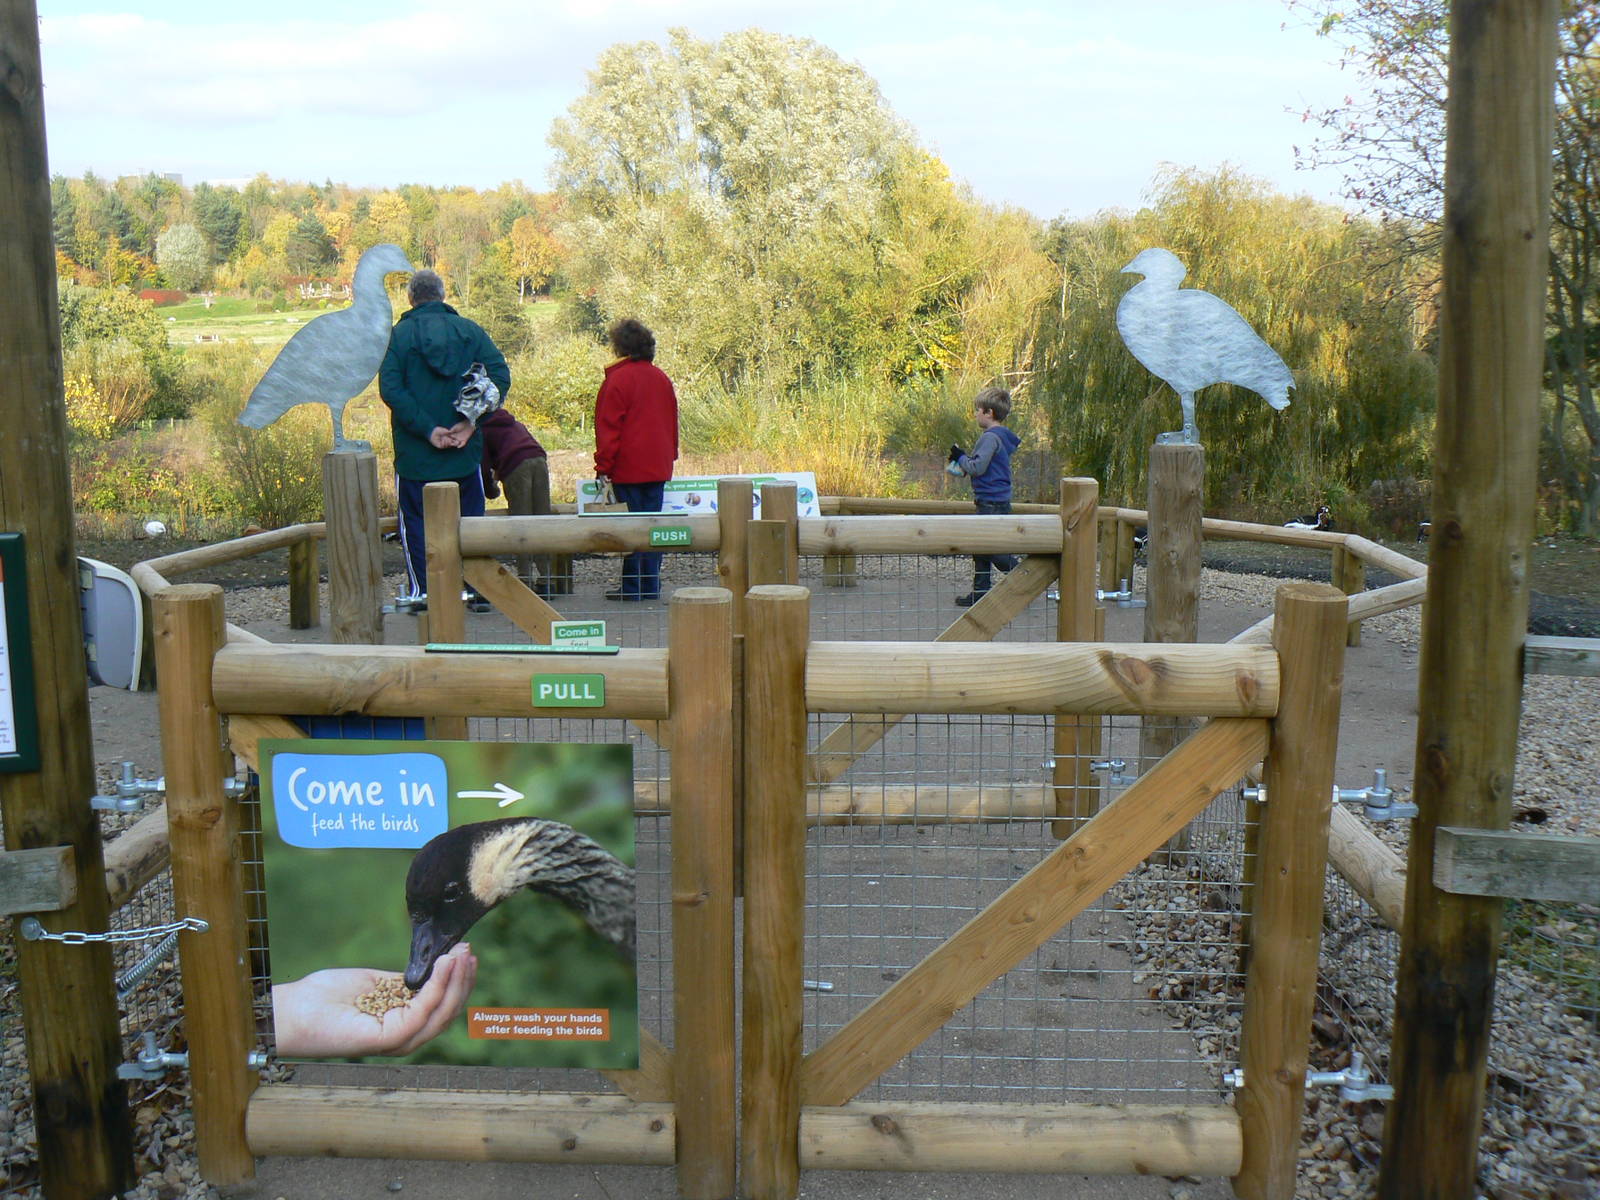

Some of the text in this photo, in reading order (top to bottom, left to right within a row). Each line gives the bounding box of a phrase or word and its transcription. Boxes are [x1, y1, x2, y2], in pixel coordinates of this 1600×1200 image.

[653, 531, 687, 541] PUSH
[559, 626, 600, 637] Come in
[540, 683, 596, 700] PULL
[288, 767, 436, 812] Come in
[312, 812, 420, 837] feed the birds
[473, 1012, 603, 1024] Always wash your hands
[484, 1025, 603, 1036] after feeding the birds
